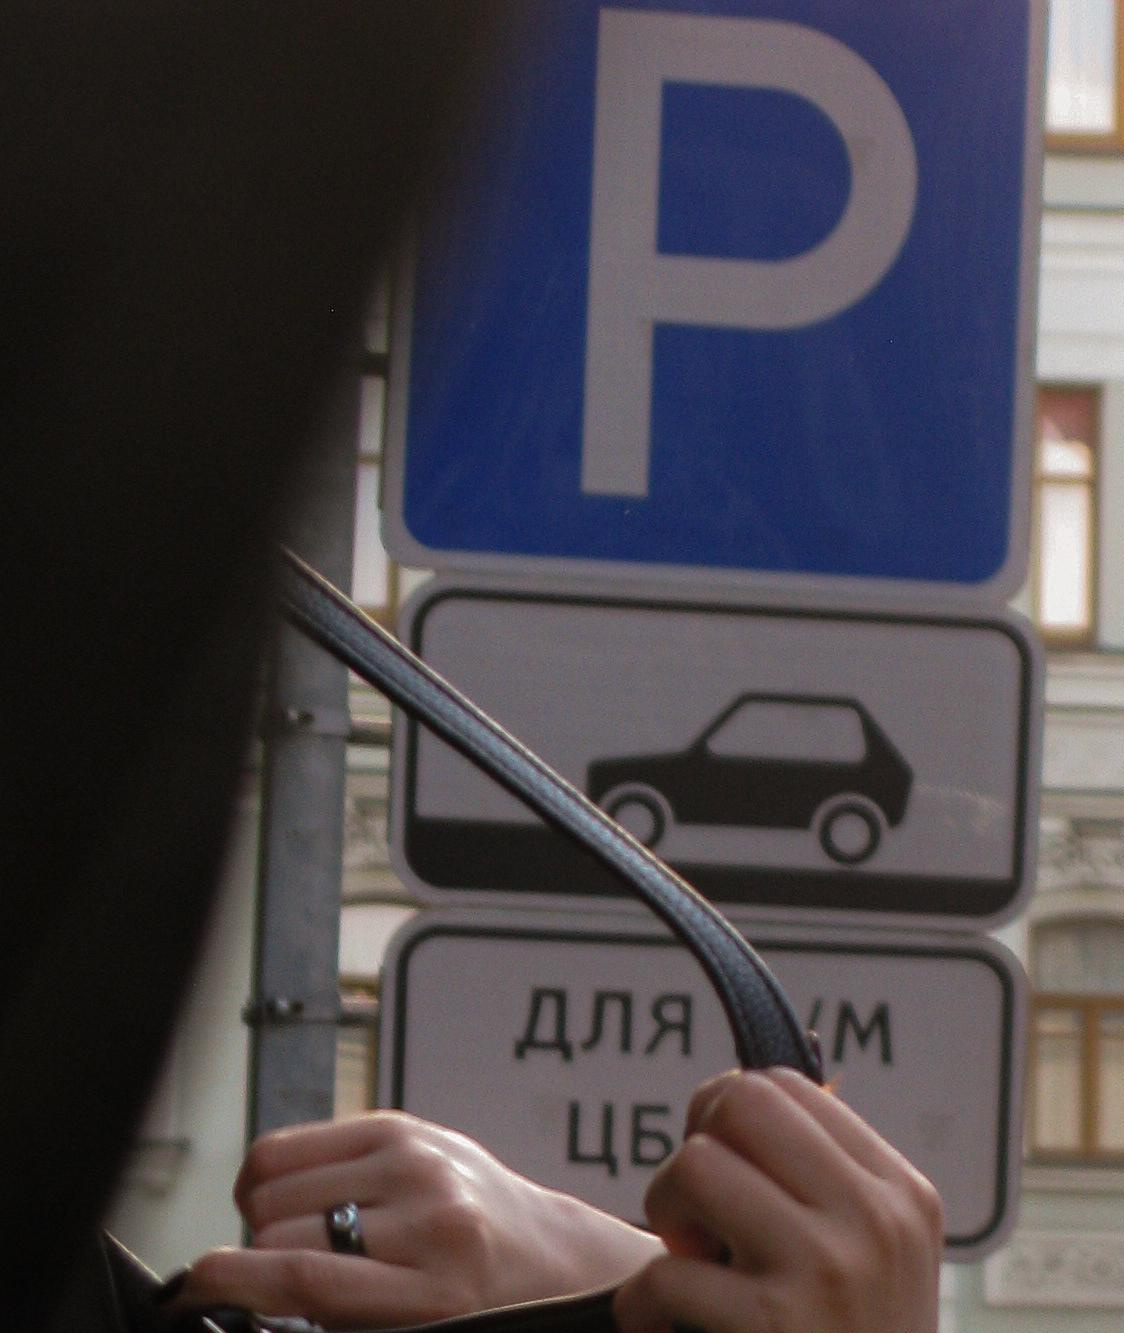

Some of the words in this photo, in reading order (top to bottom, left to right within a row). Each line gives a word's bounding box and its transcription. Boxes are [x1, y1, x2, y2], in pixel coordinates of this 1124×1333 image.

[580, 8, 919, 498] P
[514, 986, 693, 1062] ДЛЯ
[567, 1101, 674, 1177] ЦБ
